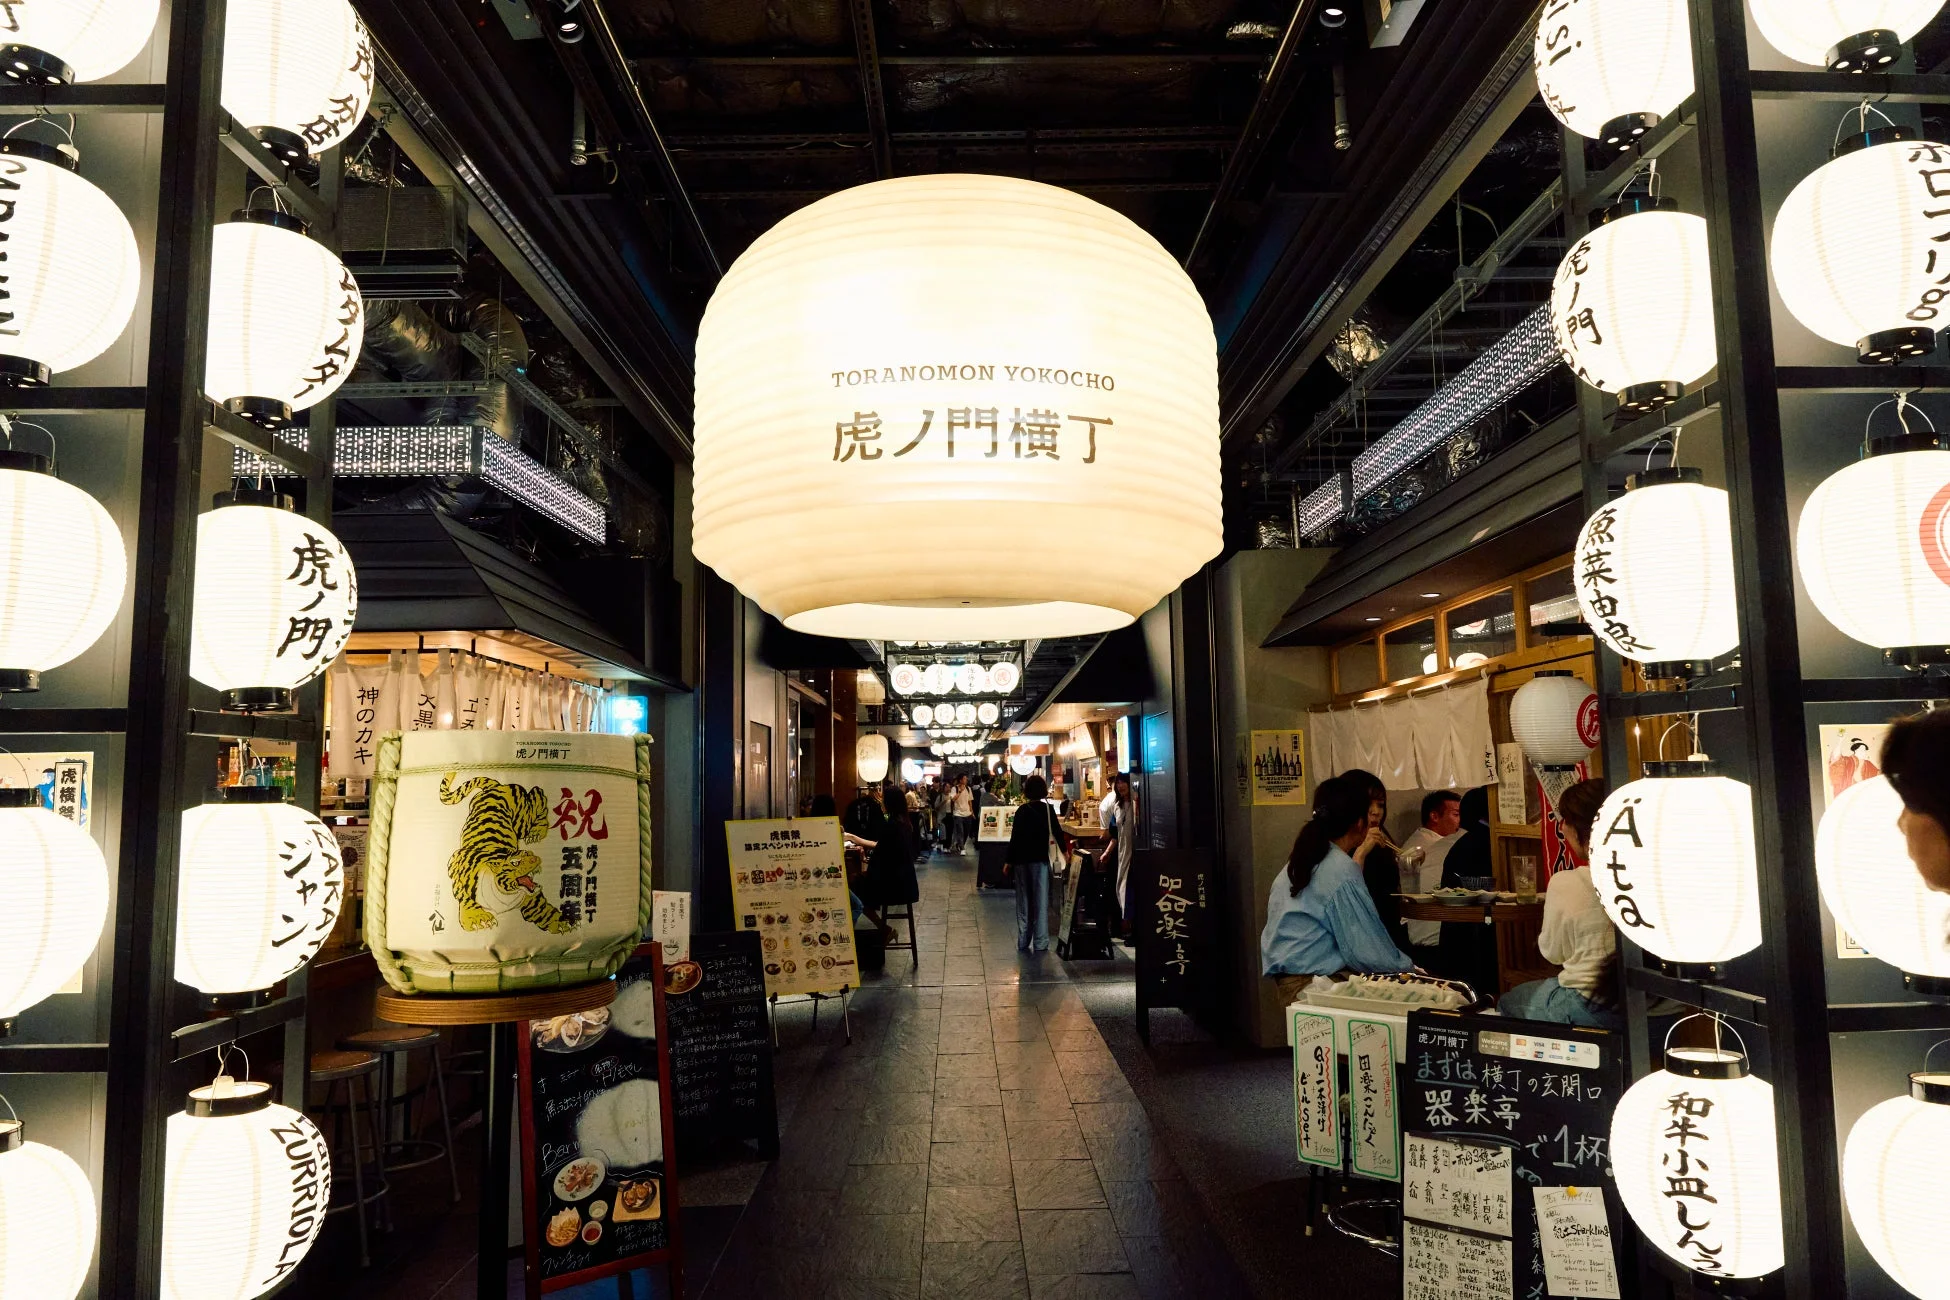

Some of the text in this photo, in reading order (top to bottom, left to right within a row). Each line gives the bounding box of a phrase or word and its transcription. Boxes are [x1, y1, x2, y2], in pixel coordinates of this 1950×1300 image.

[1562, 240, 1603, 352] 虎ノ門
[832, 365, 1115, 391] TORANOMON YOKOCHO
[833, 407, 1114, 464] 虎ノ門横丁
[276, 533, 338, 660] 虎ノ門
[353, 686, 379, 765] 神のカキ
[516, 748, 570, 759] 虎ノ門横丁
[547, 787, 609, 841] 祝
[770, 830, 801, 841] 虎横祭
[745, 841, 828, 851] 限定スペシャルメニュー
[1602, 798, 1655, 929] Äta
[271, 839, 318, 948] ジャン
[560, 846, 583, 926] 五周年
[585, 844, 598, 923] 虎ノ門横丁
[1418, 1032, 1468, 1049] 虎ノ門横丁
[1481, 1037, 1508, 1047] Welcome
[1416, 1051, 1477, 1081] まずは
[1481, 1061, 1603, 1102] 横丁の玄関口
[1425, 1088, 1521, 1130] 器楽亭
[269, 1122, 319, 1286] ZURRIOLA
